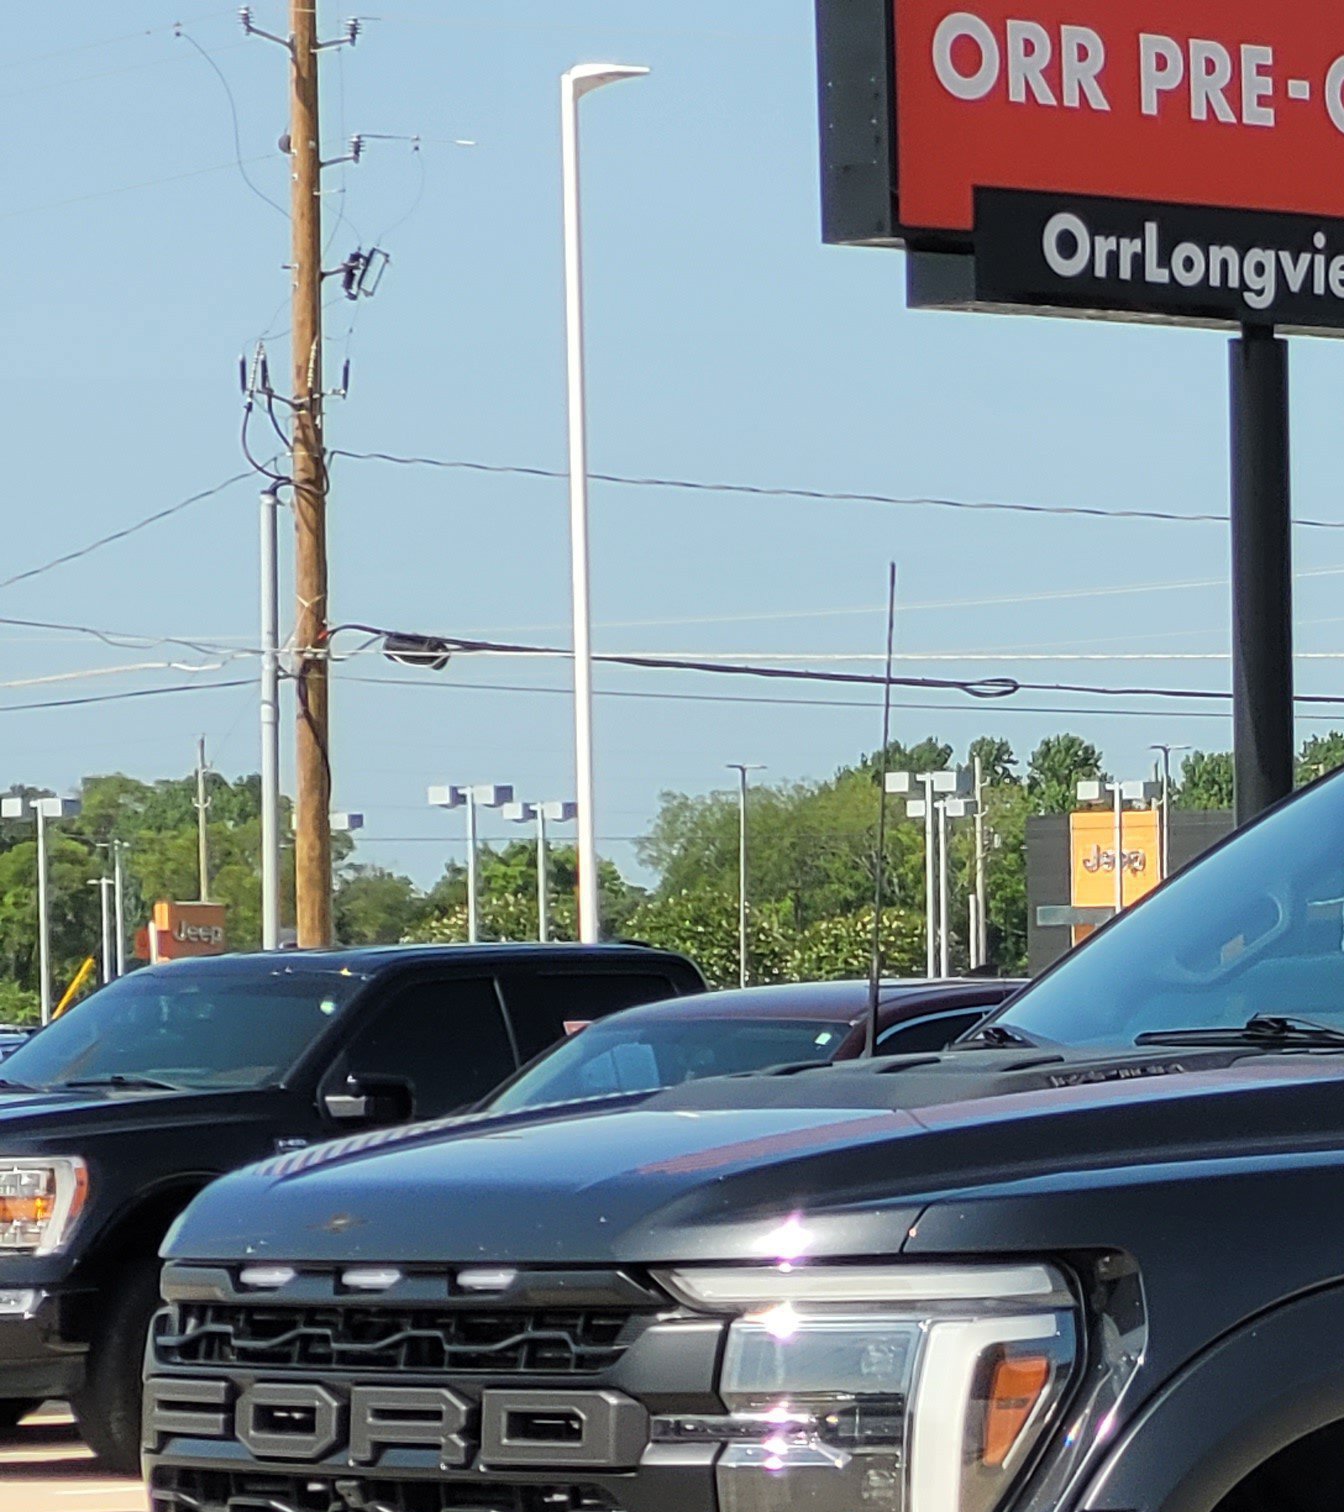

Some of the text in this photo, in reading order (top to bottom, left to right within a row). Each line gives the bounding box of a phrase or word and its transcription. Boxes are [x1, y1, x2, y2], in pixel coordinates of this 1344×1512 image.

[931, 10, 1110, 112] ORR
[173, 919, 224, 945] Jeep
[144, 1376, 651, 1474] FORD
